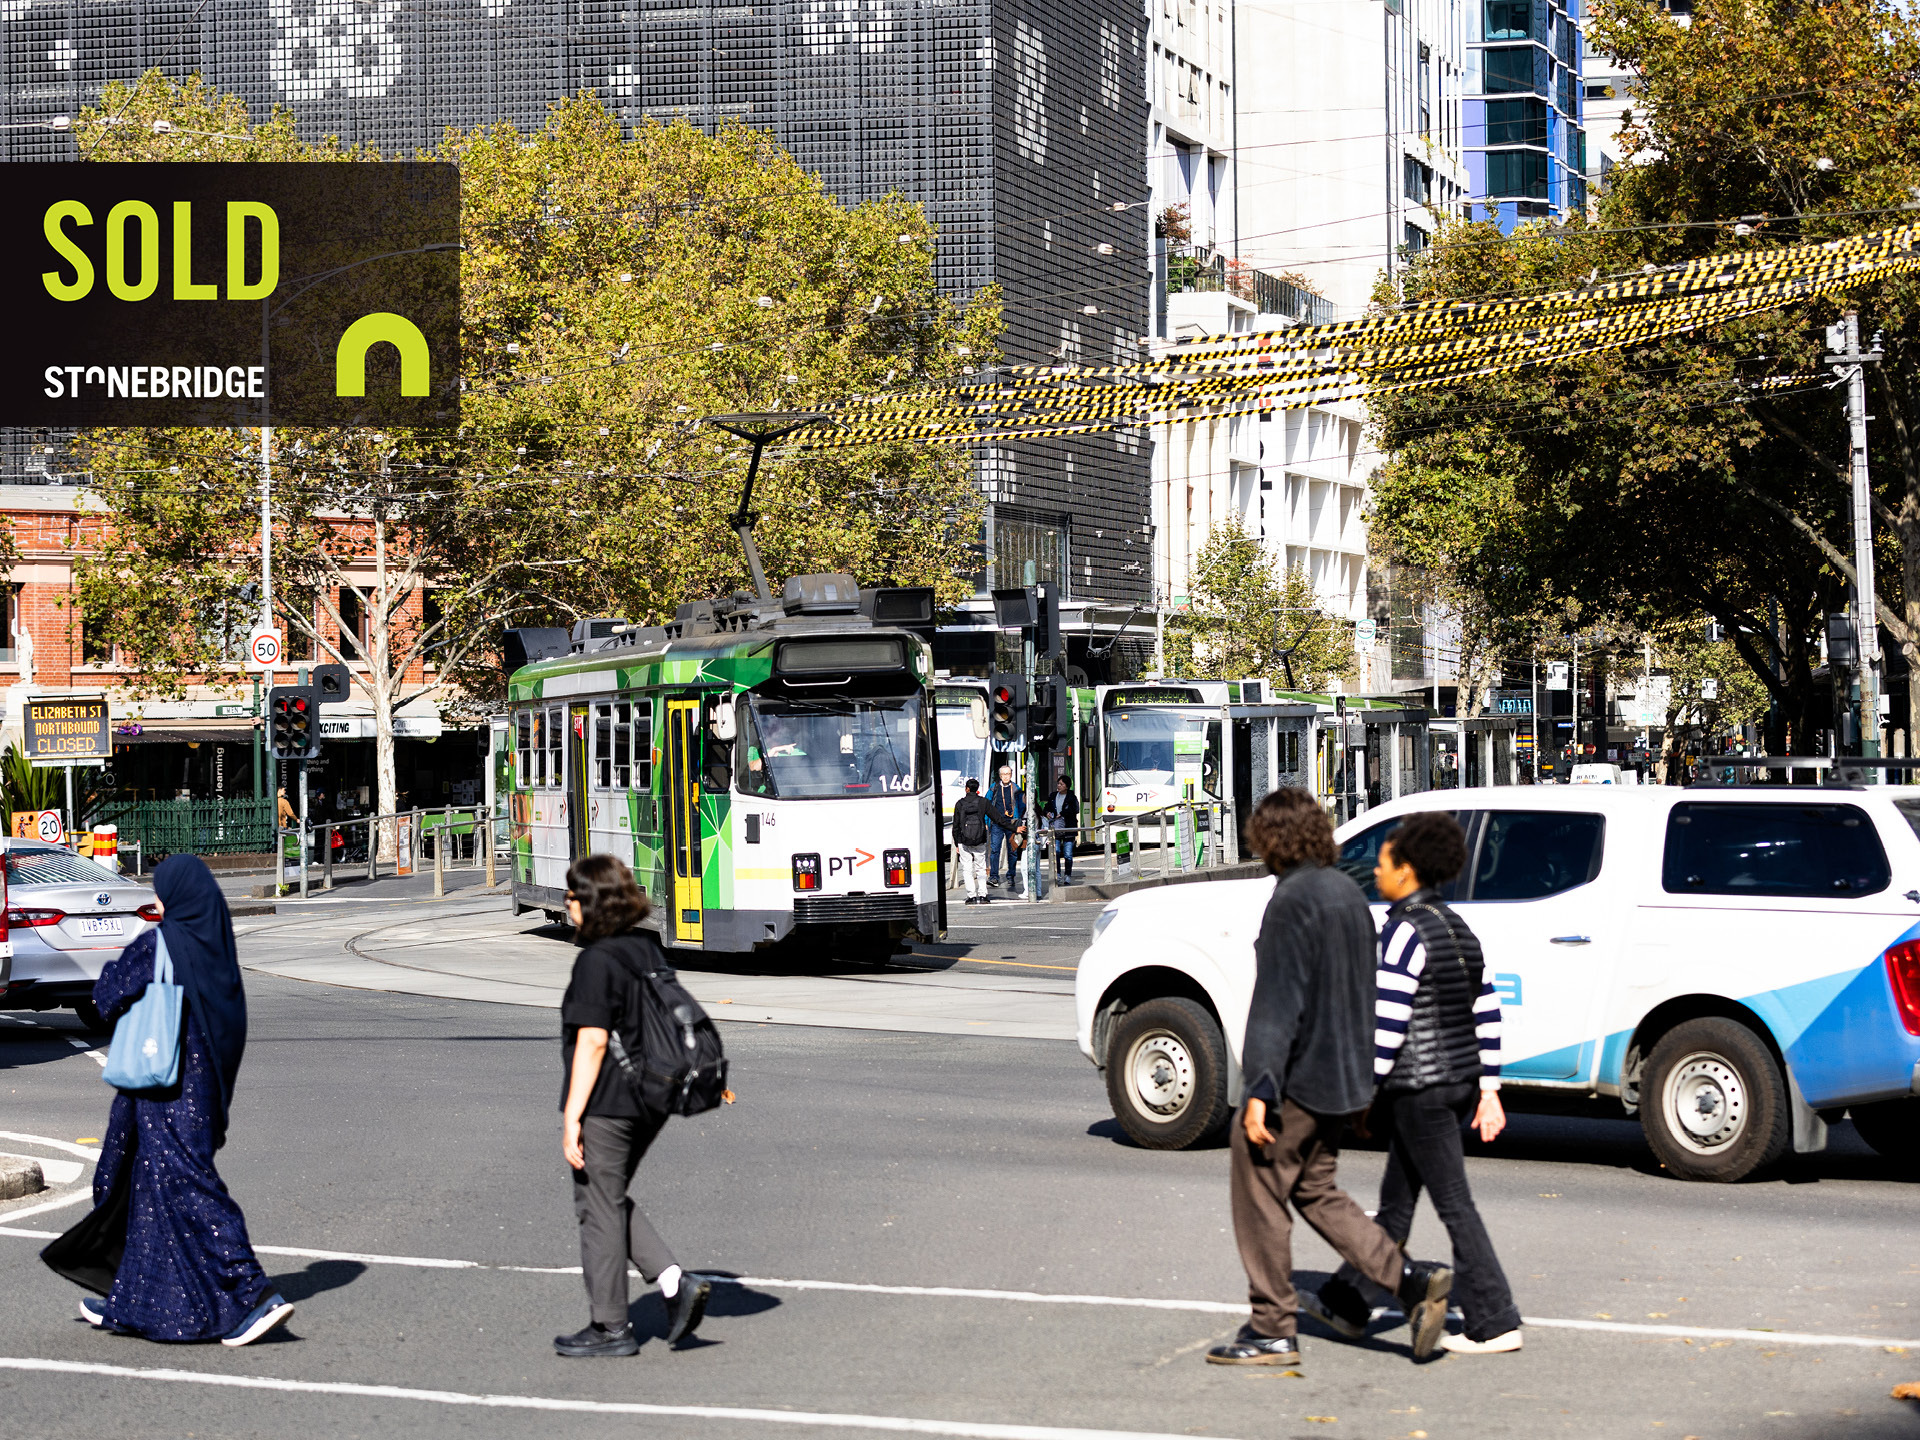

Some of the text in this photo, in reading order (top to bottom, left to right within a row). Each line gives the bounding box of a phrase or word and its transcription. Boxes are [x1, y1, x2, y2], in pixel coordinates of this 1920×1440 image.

[258, 643, 276, 656] 50
[31, 705, 102, 720] ELIZABETH ST
[35, 720, 100, 736] NORTHBOUND
[319, 723, 349, 733] XCITING
[37, 737, 96, 753] CLOSED
[215, 747, 224, 791] learning
[879, 774, 912, 793] 146
[761, 812, 776, 826] 146
[41, 820, 58, 835] 20
[829, 856, 857, 876] PT
